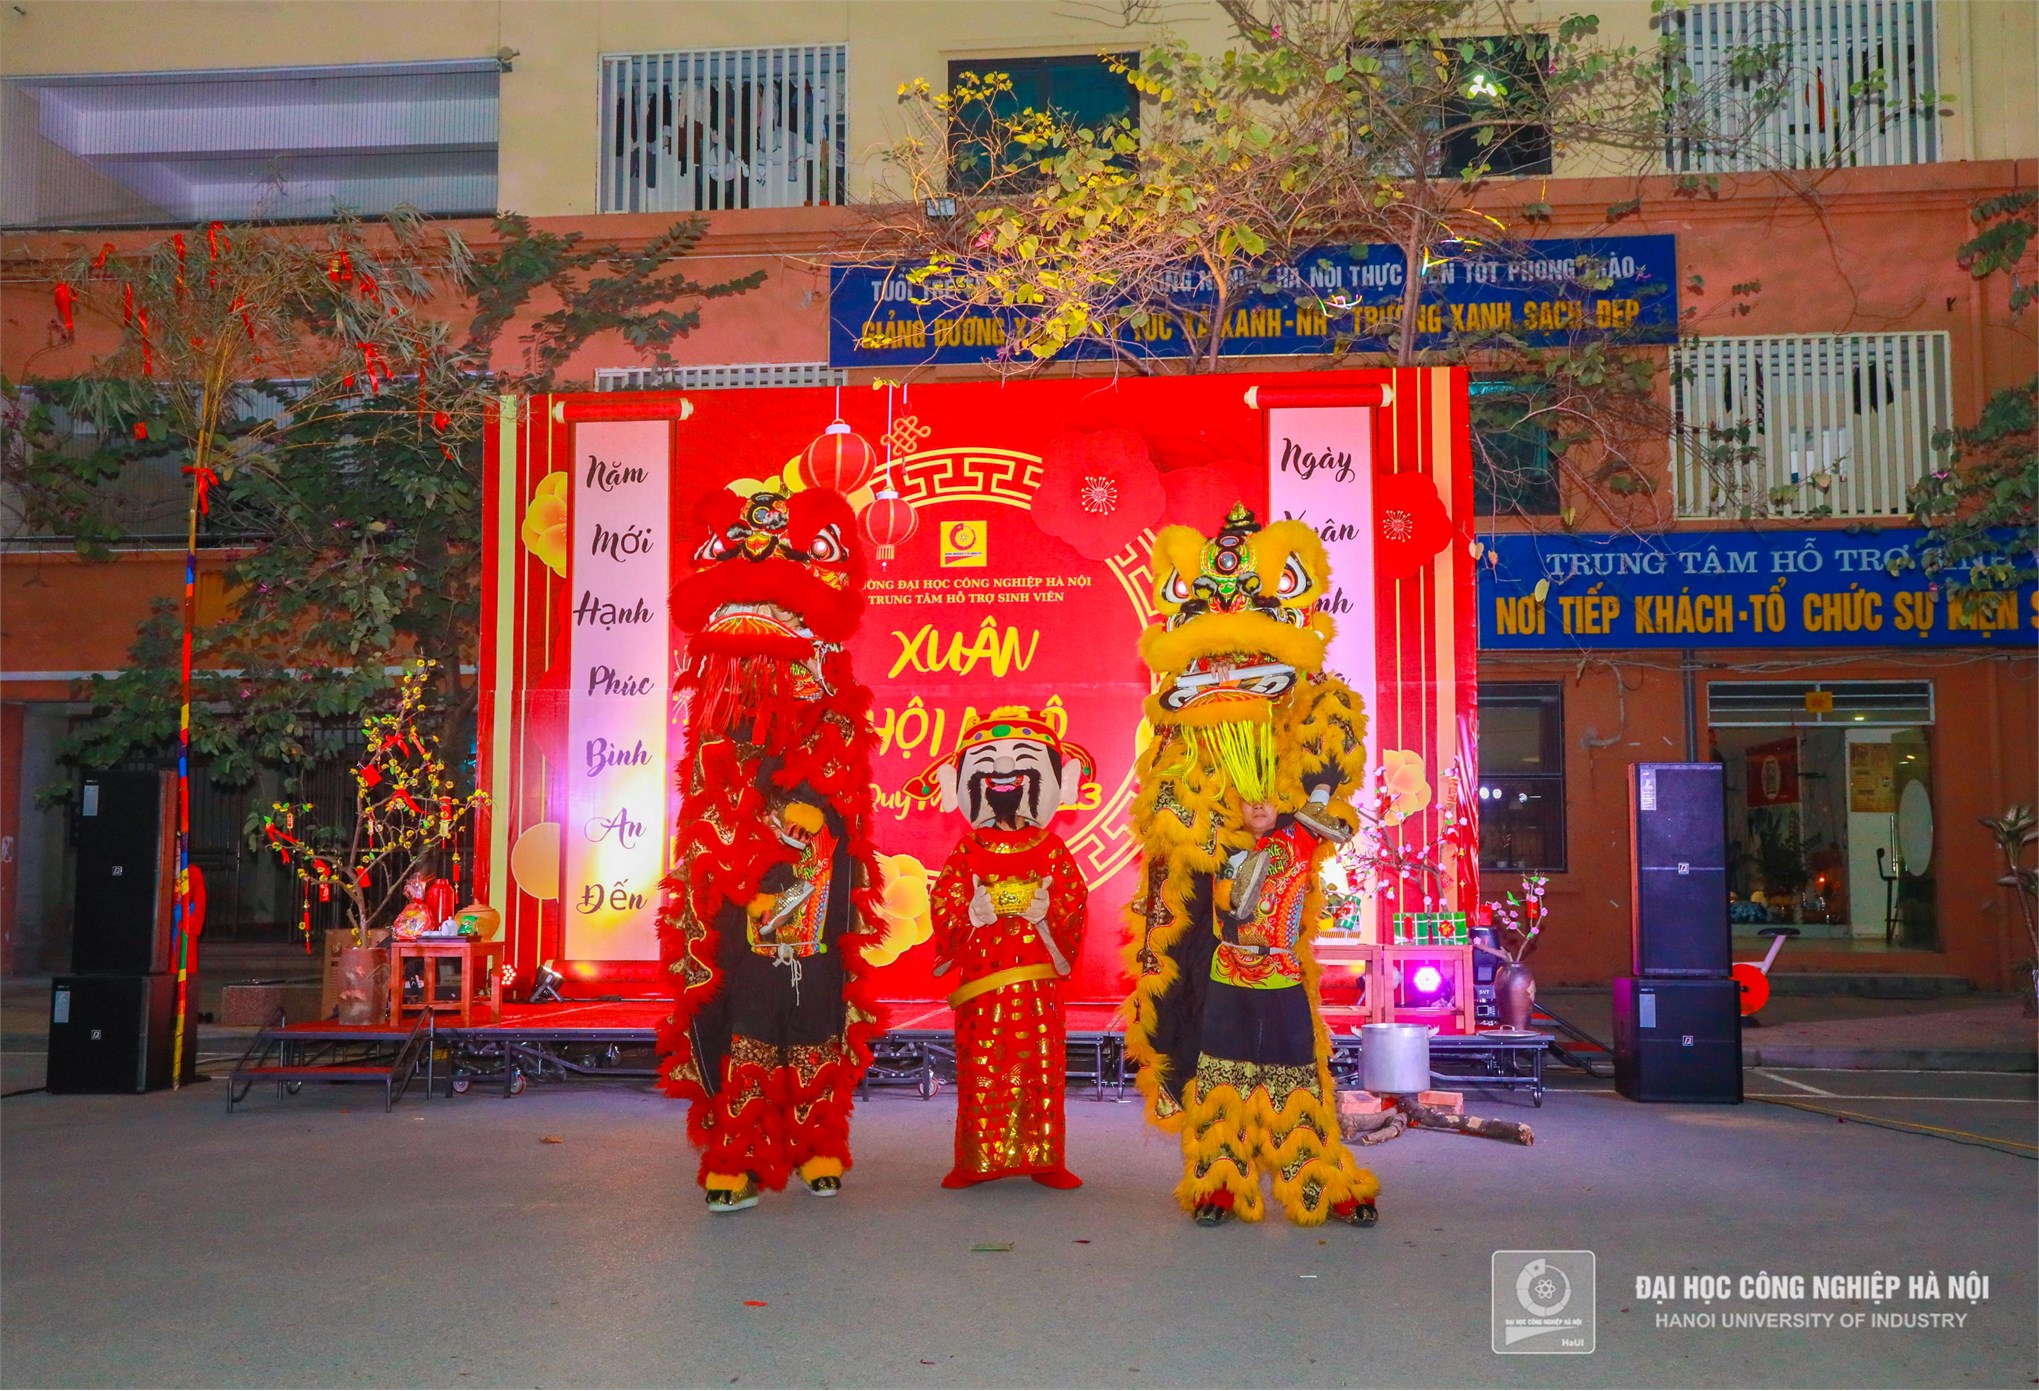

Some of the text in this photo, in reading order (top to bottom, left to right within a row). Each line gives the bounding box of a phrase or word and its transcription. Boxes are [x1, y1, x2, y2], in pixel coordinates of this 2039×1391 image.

[1349, 262, 1403, 291] THỰC
[862, 309, 926, 349] GIẢNG
[1450, 301, 1512, 333] XANH
[586, 454, 649, 493] Năm
[1280, 437, 1356, 483] Ngày
[592, 523, 654, 563] Mới
[1283, 509, 1359, 543] ân
[1546, 552, 1668, 577] TRUNG
[1679, 545, 1759, 574] TÂM
[1770, 537, 1824, 573] HỖ
[868, 590, 1065, 605] TRUNG TÂM HỖ TRỢ SINH VIÊN
[897, 579, 920, 591] ĐẠI
[923, 578, 951, 591] HỌC
[953, 577, 990, 589] CÔNG
[993, 575, 1043, 589] NGHIỆP
[1046, 575, 1064, 587] HÀ
[1067, 574, 1092, 588] NỘI
[573, 589, 654, 631] Hạnh
[1558, 581, 1621, 634] TIẾP
[1802, 582, 1883, 632] CHỨC
[888, 614, 1040, 679] XUÂN
[588, 665, 655, 697] Phúc
[586, 737, 653, 778] Bình
[584, 806, 647, 850] An
[576, 878, 648, 915] Đến
